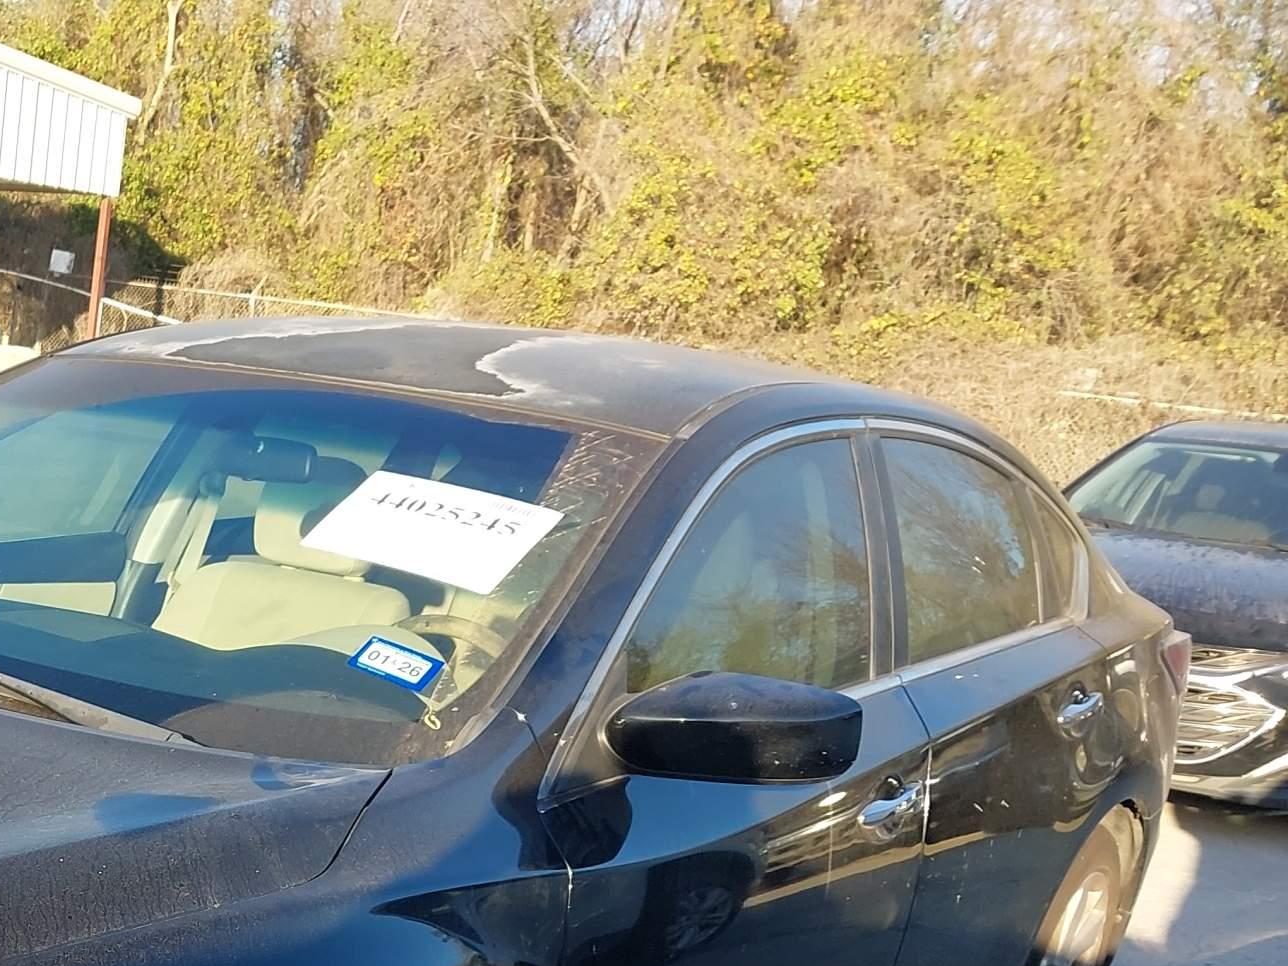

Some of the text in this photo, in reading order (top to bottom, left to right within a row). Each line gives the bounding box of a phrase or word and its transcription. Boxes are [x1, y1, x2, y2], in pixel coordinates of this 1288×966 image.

[371, 493, 522, 535] 44025245
[367, 650, 424, 678] 01 26
